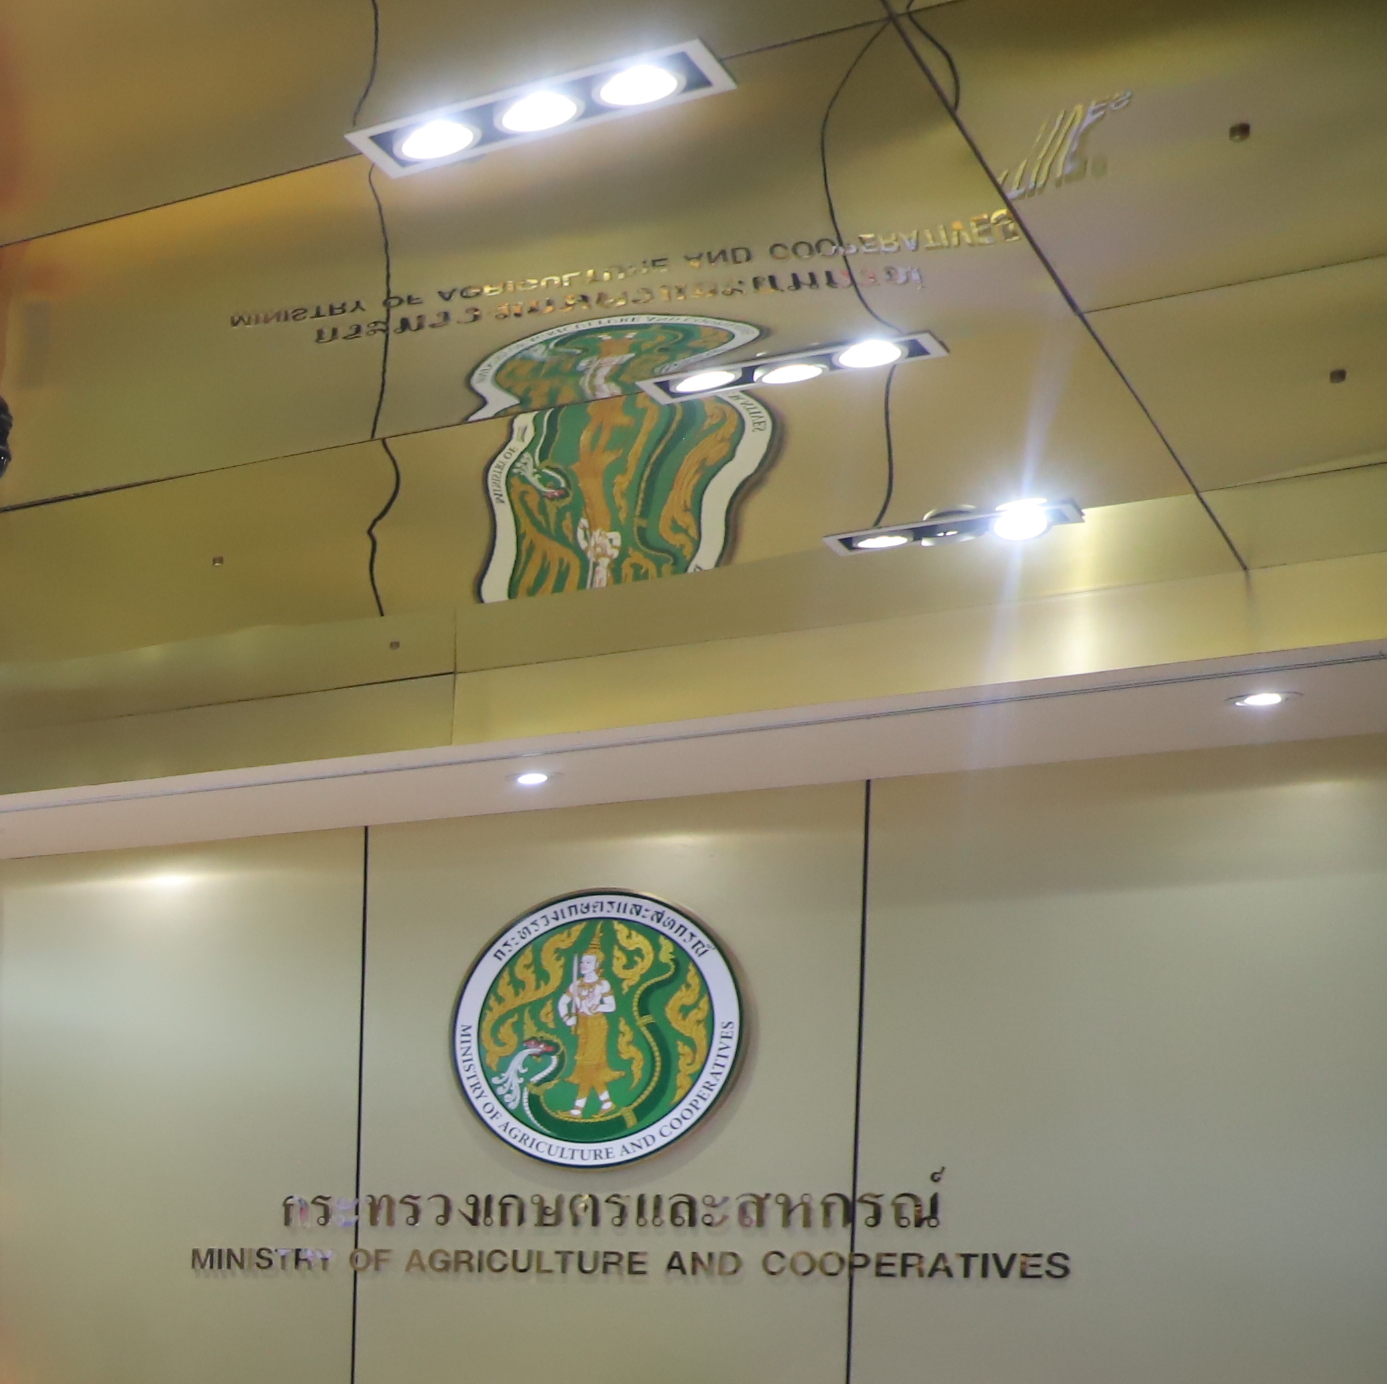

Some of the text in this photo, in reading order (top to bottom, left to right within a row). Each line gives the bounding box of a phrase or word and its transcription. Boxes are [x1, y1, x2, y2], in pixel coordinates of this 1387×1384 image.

[458, 1020, 736, 1162] MINISTRY OF AGRICULTURE AND COOPERATIVES
[281, 1165, 947, 1229] กระทรวงเกษตรและสหกรณ์
[190, 1246, 1072, 1279] MINISTRY OF AGRICULTURE AND COOPERATIVES
